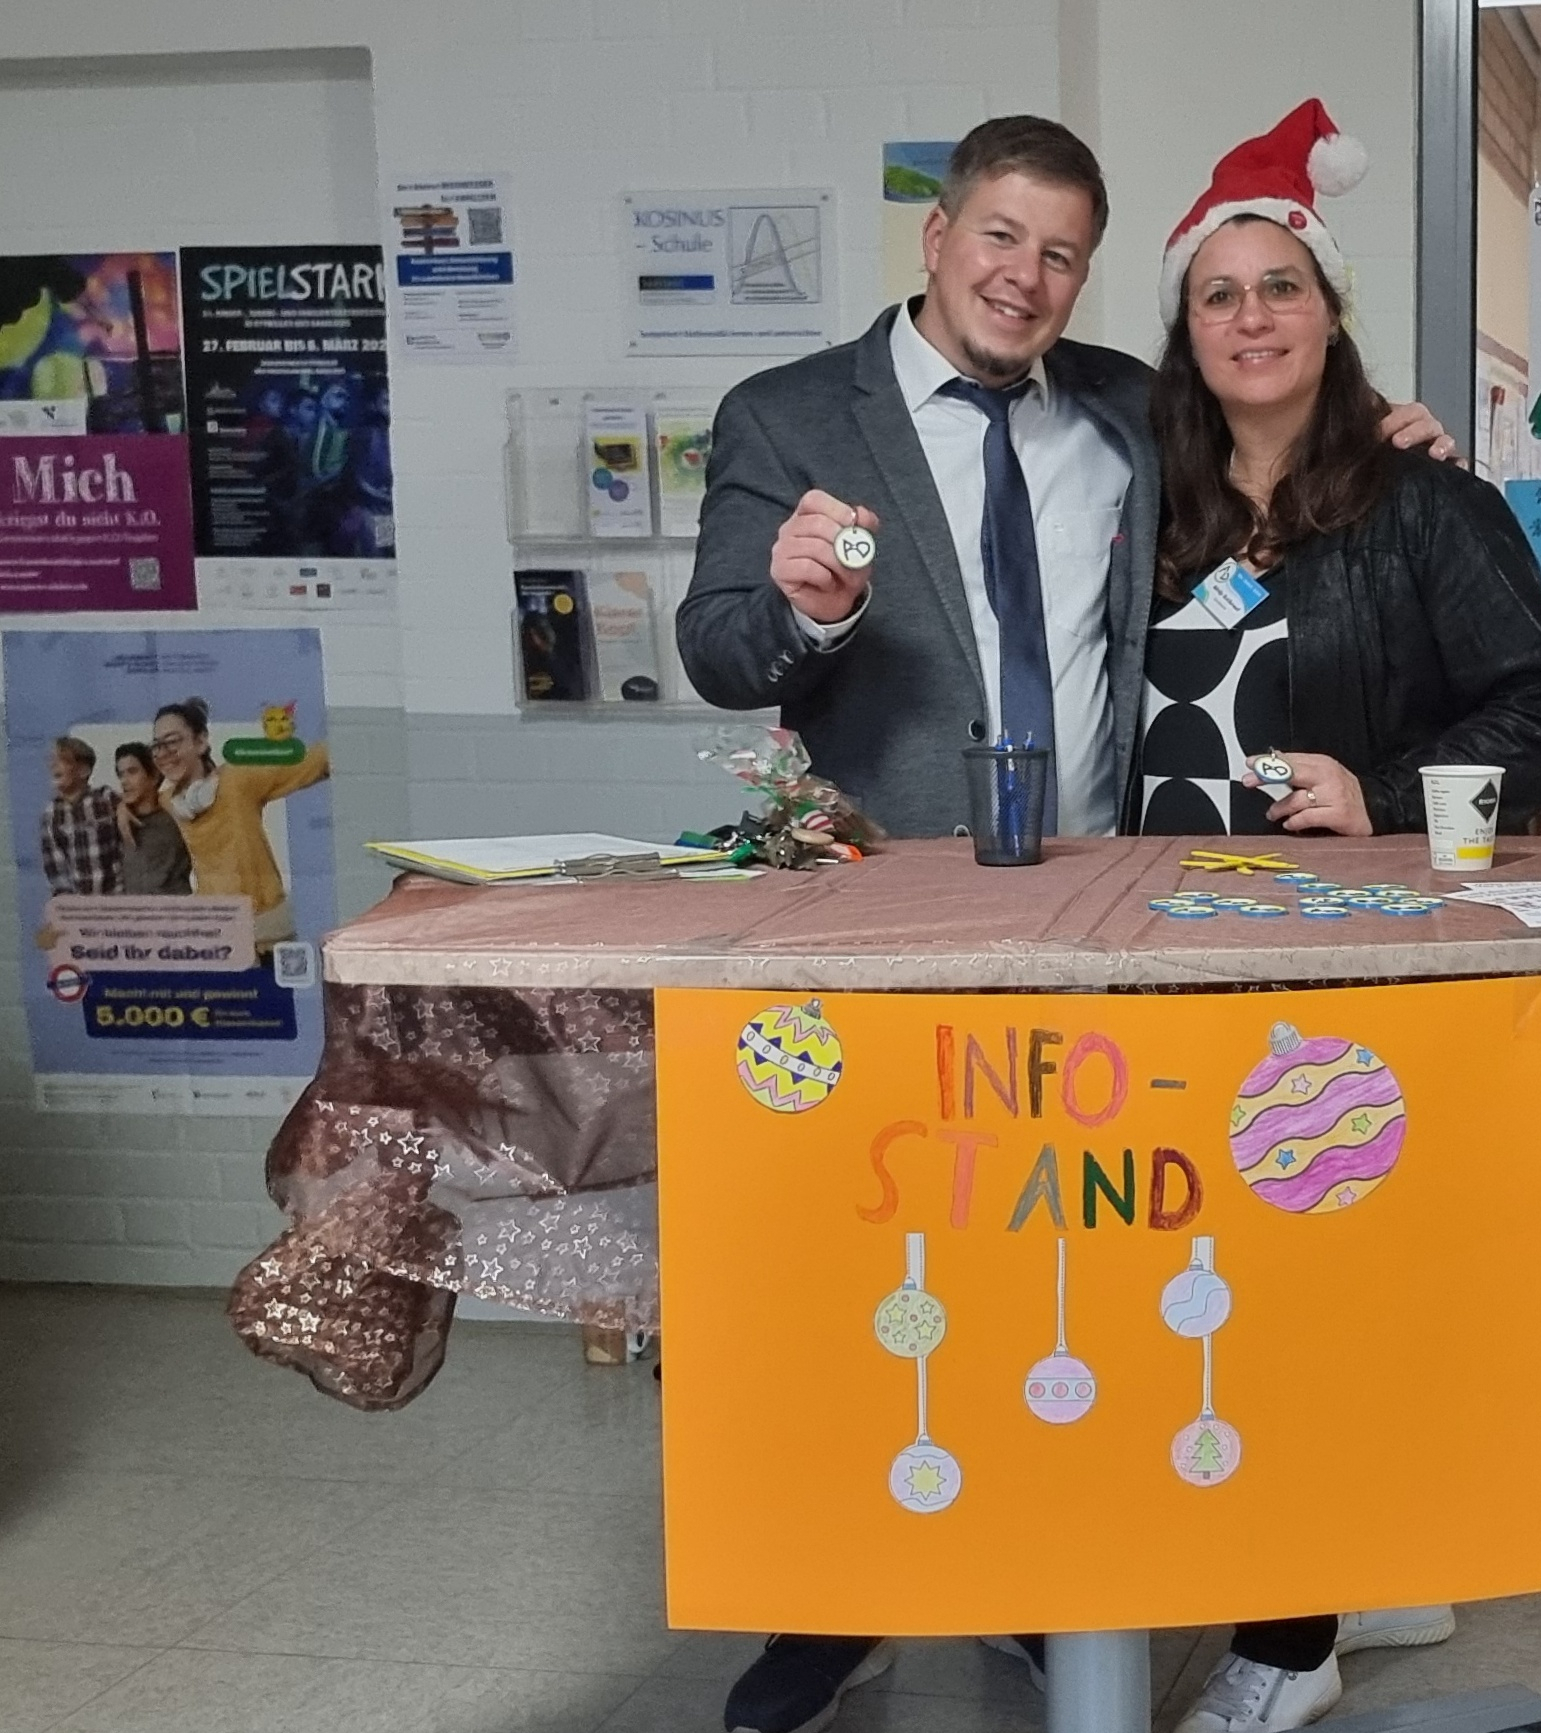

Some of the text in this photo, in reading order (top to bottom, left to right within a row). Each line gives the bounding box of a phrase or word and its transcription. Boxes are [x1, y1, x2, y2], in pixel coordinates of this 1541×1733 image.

[633, 209, 726, 227] KOSINUS
[652, 233, 714, 252] Schule
[202, 338, 224, 352] 27.
[225, 339, 282, 352] FEBRUAR
[12, 452, 138, 503] Mich
[54, 510, 78, 527] du
[82, 511, 120, 526] nicht
[70, 945, 233, 961] Seid Ihr dabei?
[96, 1005, 186, 1027] 5.000
[189, 1006, 212, 1028] €
[856, 1119, 1203, 1232] STAND
